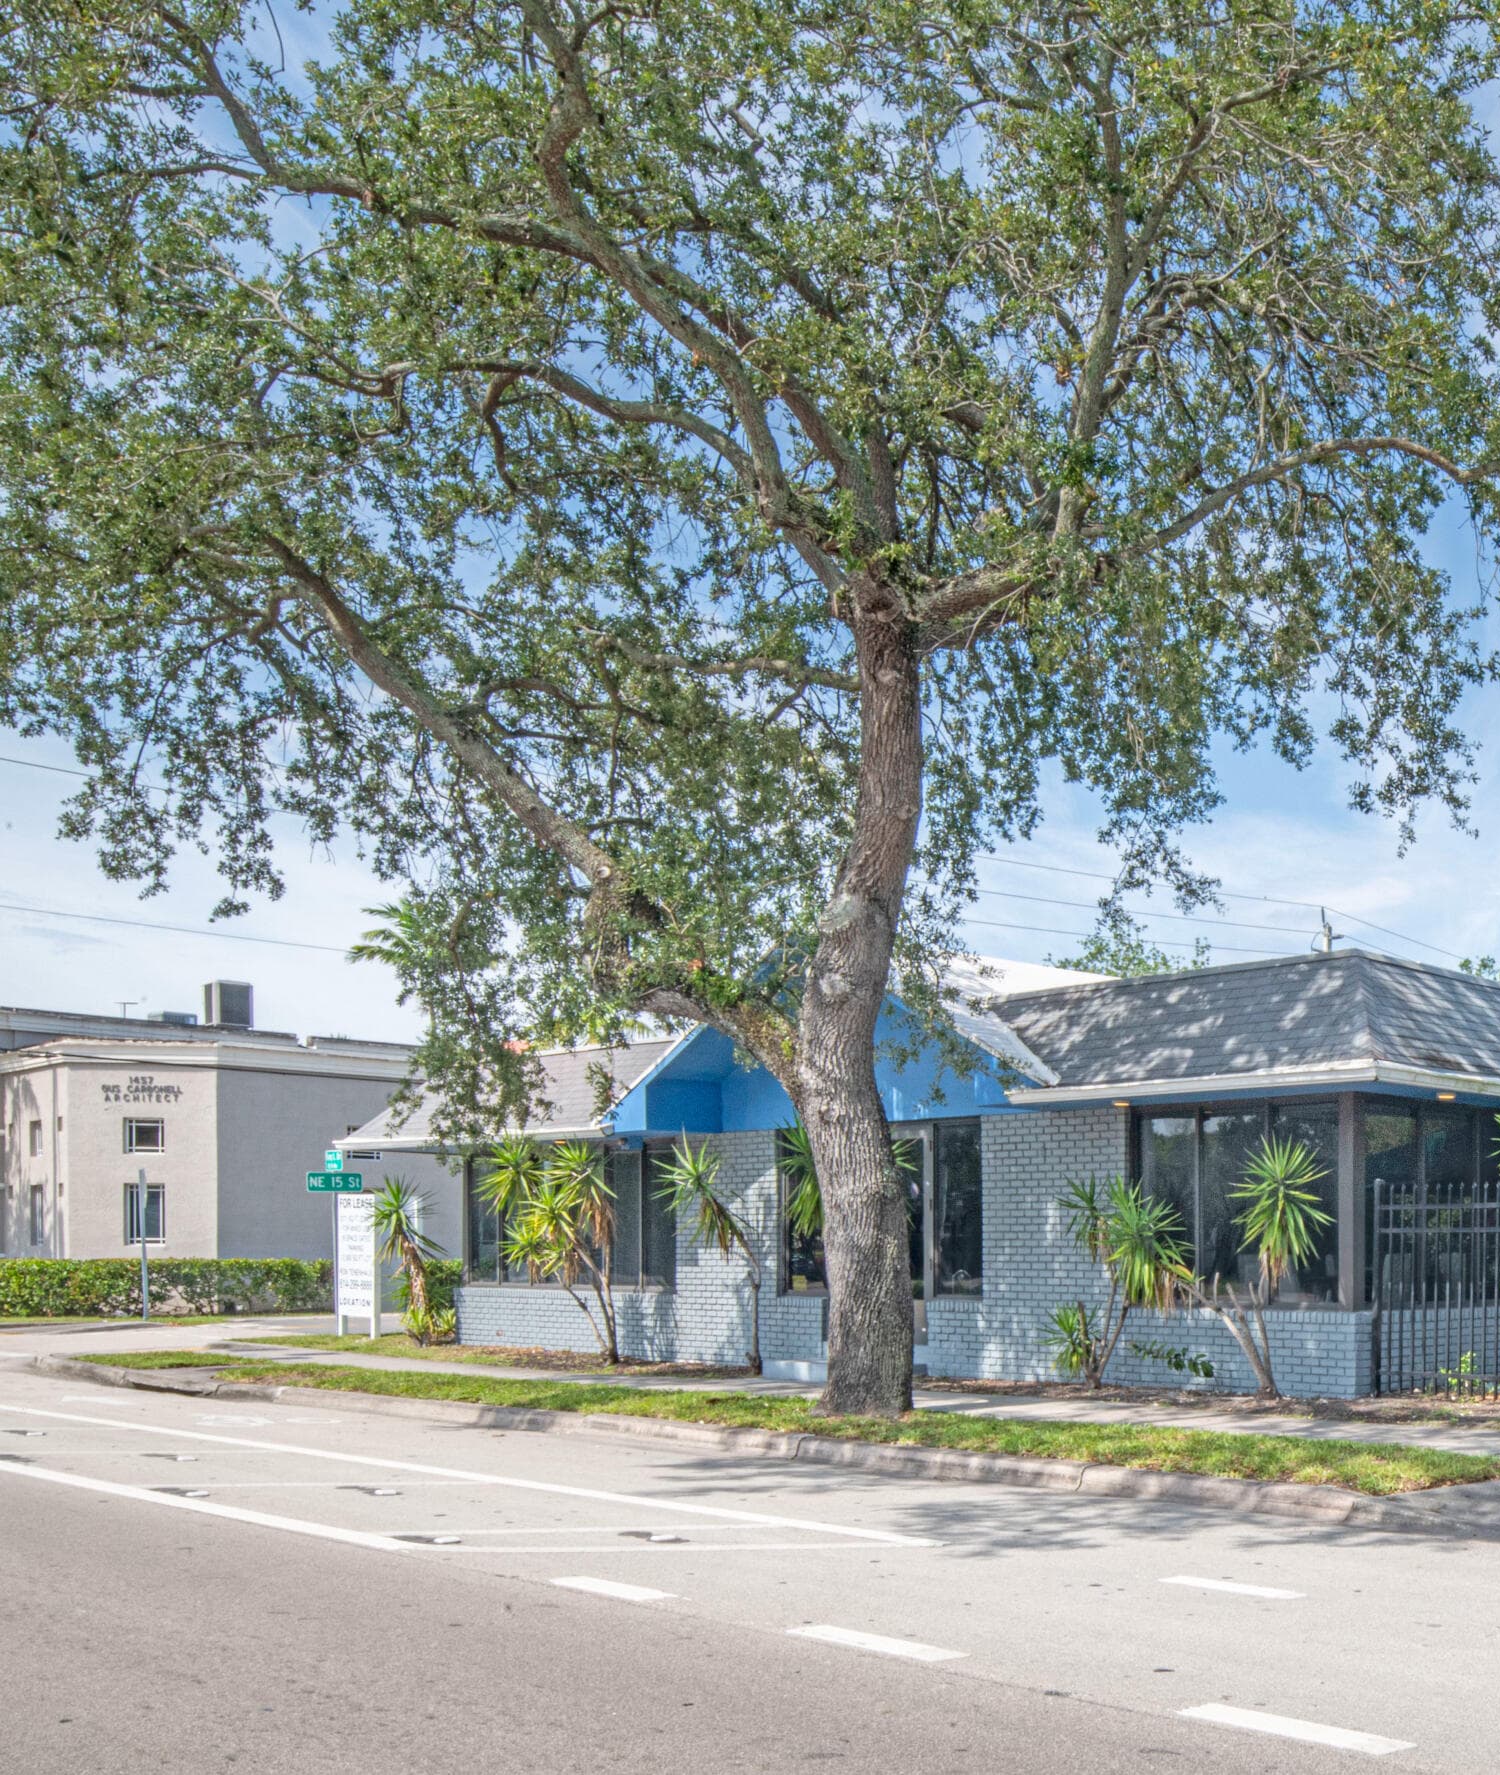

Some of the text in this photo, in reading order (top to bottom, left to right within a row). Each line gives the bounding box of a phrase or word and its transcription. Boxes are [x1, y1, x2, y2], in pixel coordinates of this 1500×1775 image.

[129, 1076, 154, 1085] 1457
[104, 1094, 179, 1103] ARCHITECT
[310, 1176, 360, 1188] NE 15 St
[340, 1198, 351, 1209] FOR
